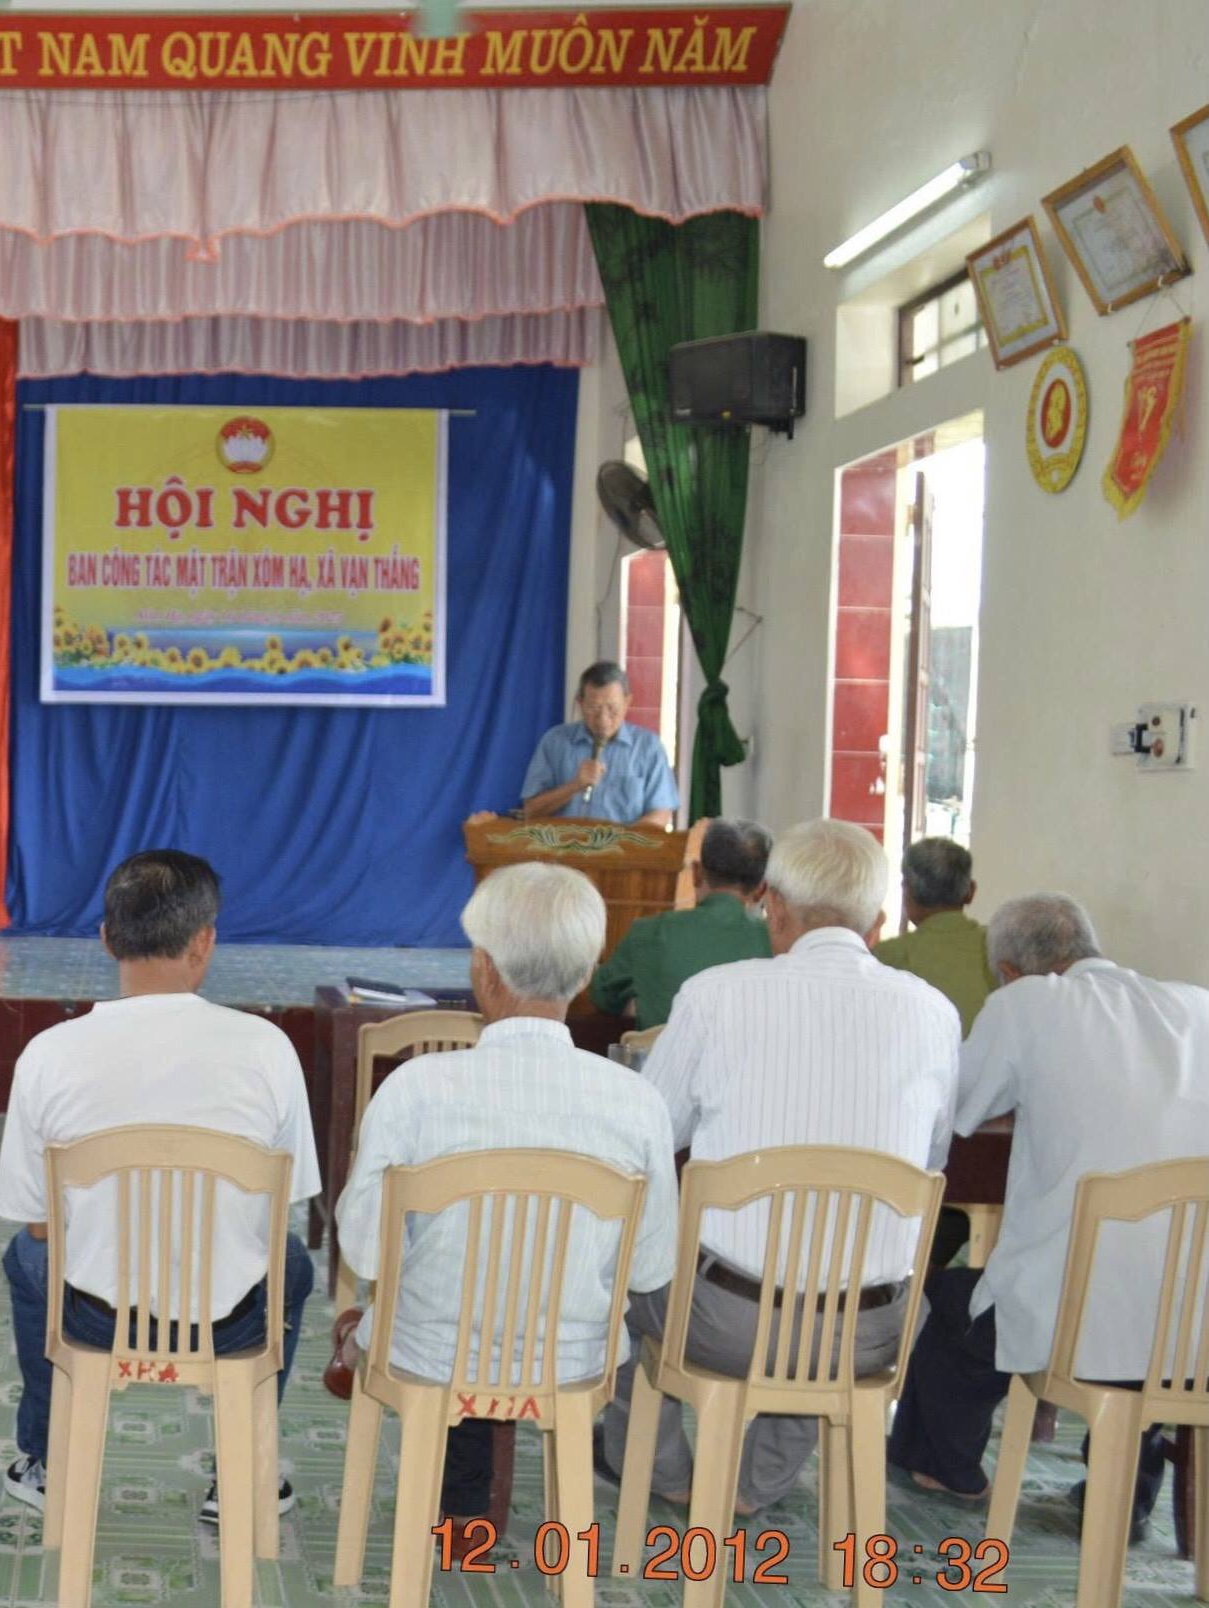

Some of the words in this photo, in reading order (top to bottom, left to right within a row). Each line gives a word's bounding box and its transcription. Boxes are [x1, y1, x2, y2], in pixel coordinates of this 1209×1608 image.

[38, 31, 153, 77] NAM
[162, 32, 333, 78] QUANG
[344, 33, 471, 75] VINH
[480, 16, 633, 74] MUÔN
[638, 14, 756, 73] NĂM
[115, 476, 214, 540] HỘI
[233, 488, 374, 541] NGHỊ
[68, 553, 97, 587] BAN
[101, 546, 140, 588] CÔNG
[145, 547, 172, 588] TÁC
[211, 548, 247, 596] TRẬN
